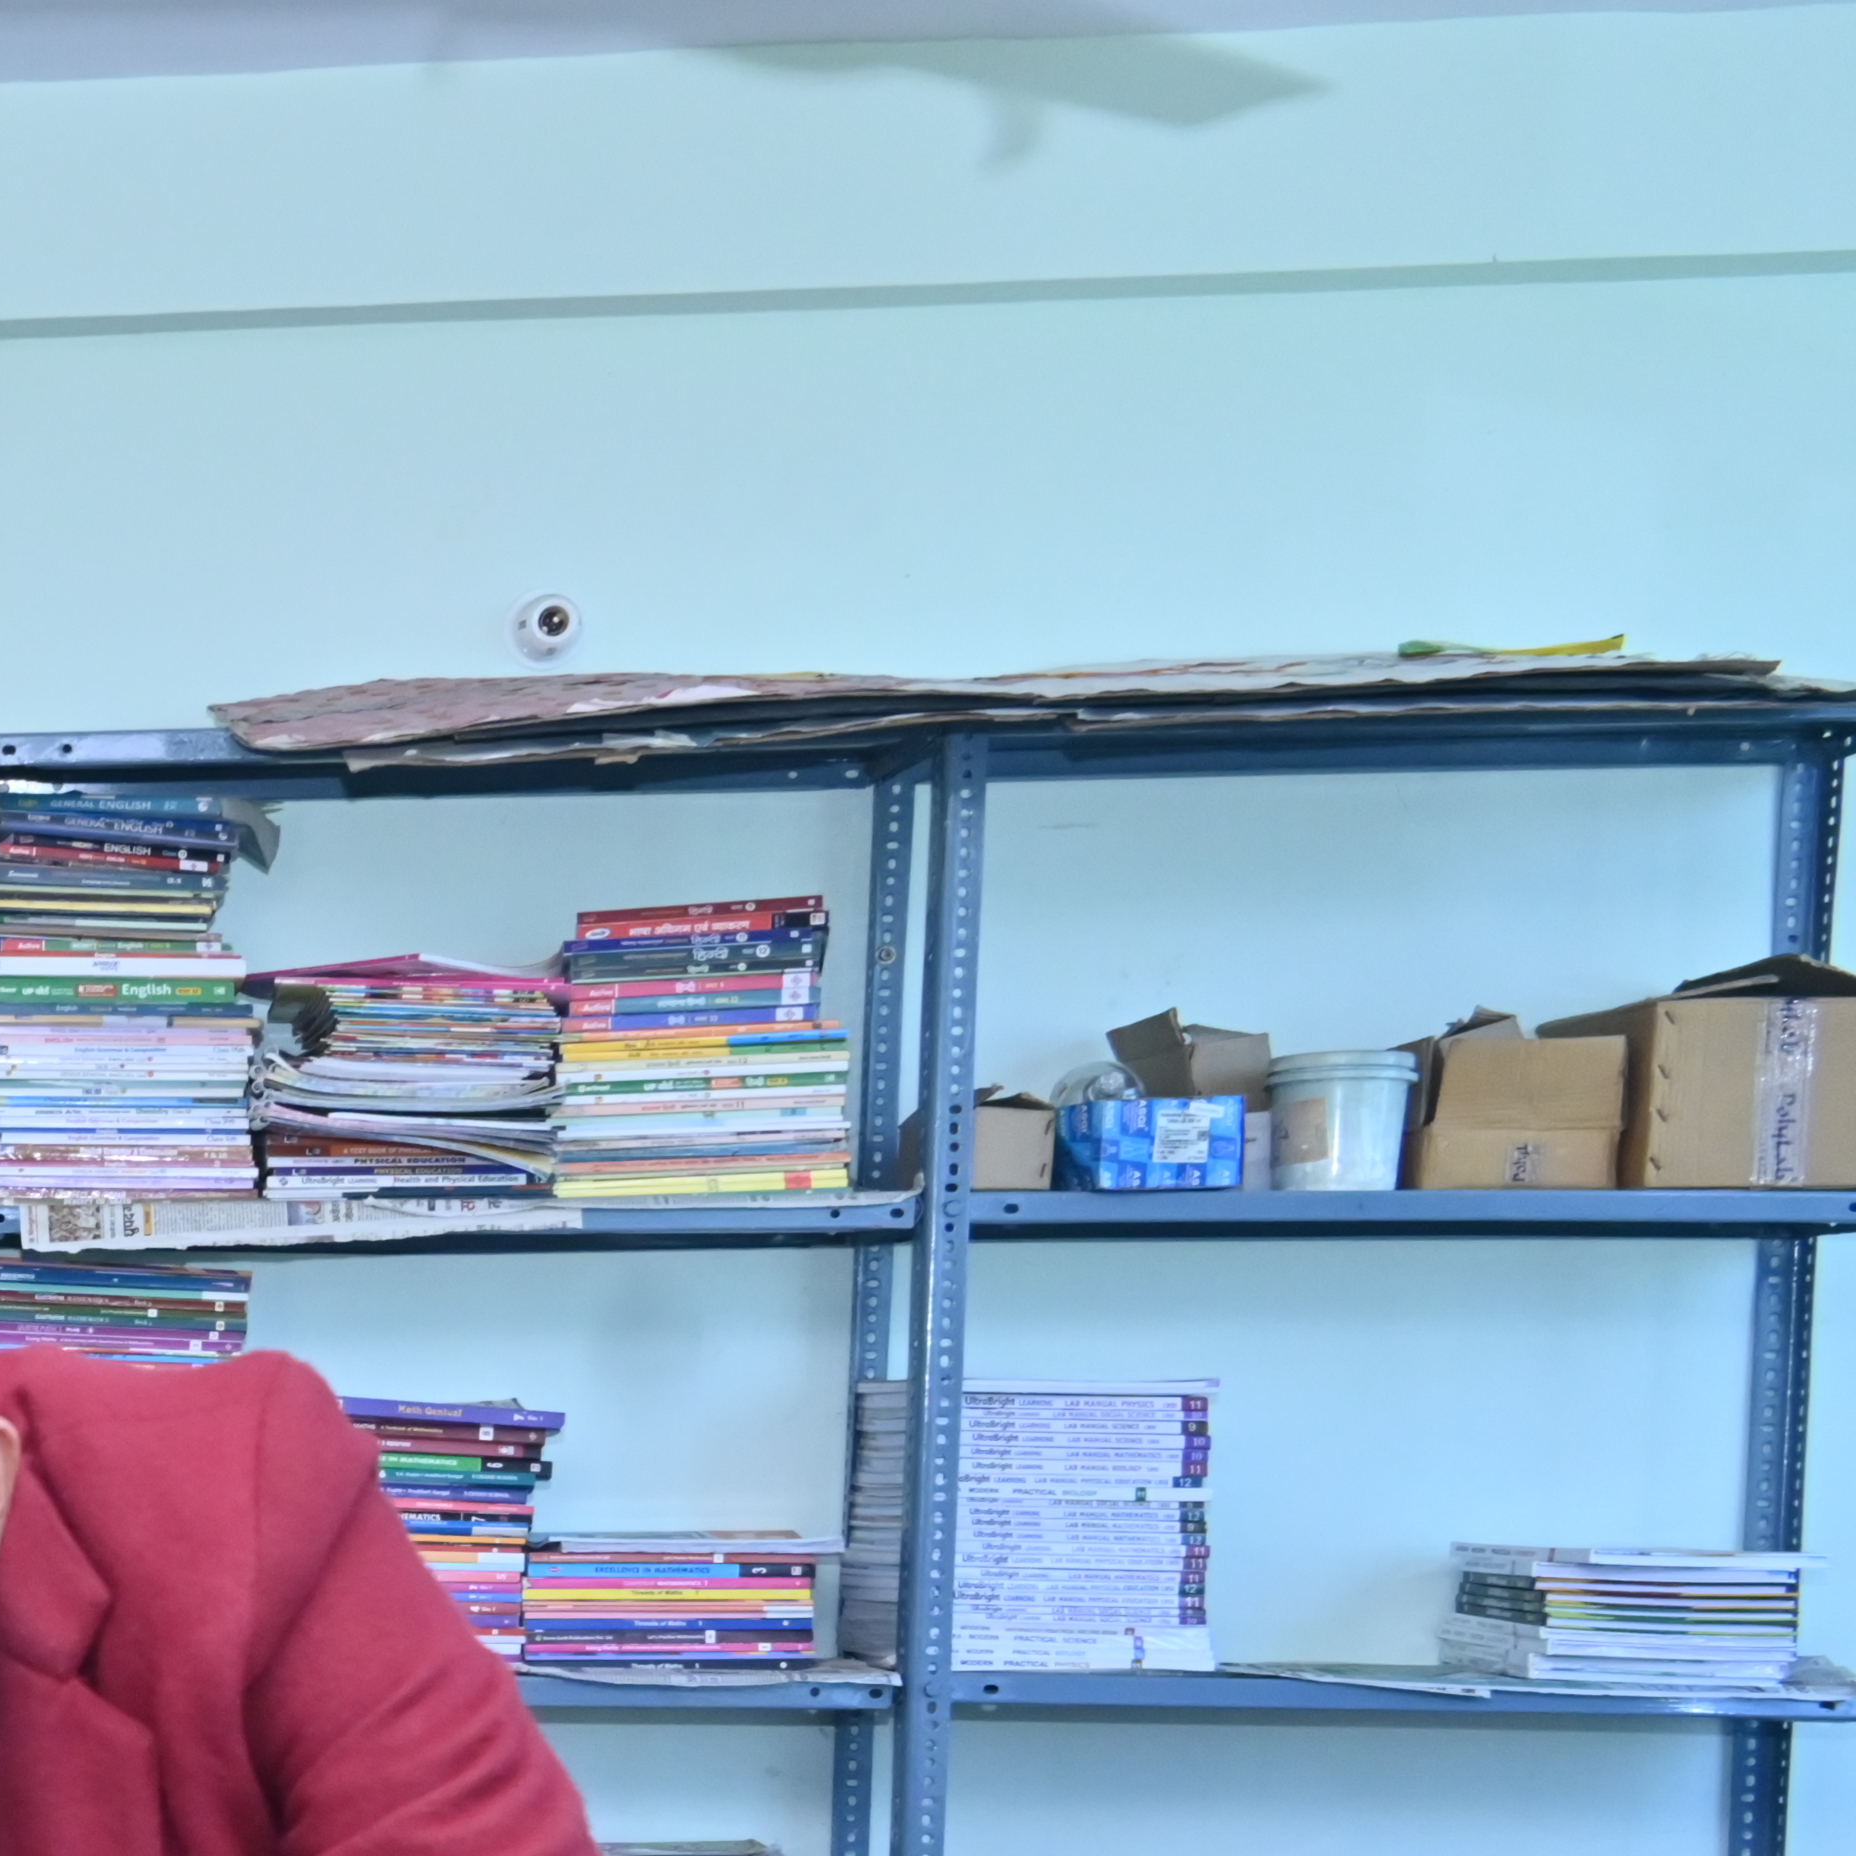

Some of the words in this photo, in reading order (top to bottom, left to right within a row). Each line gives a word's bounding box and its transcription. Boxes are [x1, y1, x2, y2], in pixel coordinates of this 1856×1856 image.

[50, 799, 94, 808] GENERAL
[99, 800, 151, 810] ENGLISH
[104, 843, 151, 856] ENGLISH
[122, 984, 171, 998] English
[442, 1175, 475, 1184] Physical
[478, 1174, 519, 1183] Education
[398, 1405, 422, 1413] Math
[400, 1457, 457, 1466] MATHEMATICS
[1012, 1488, 1057, 1496] PRACTICAL
